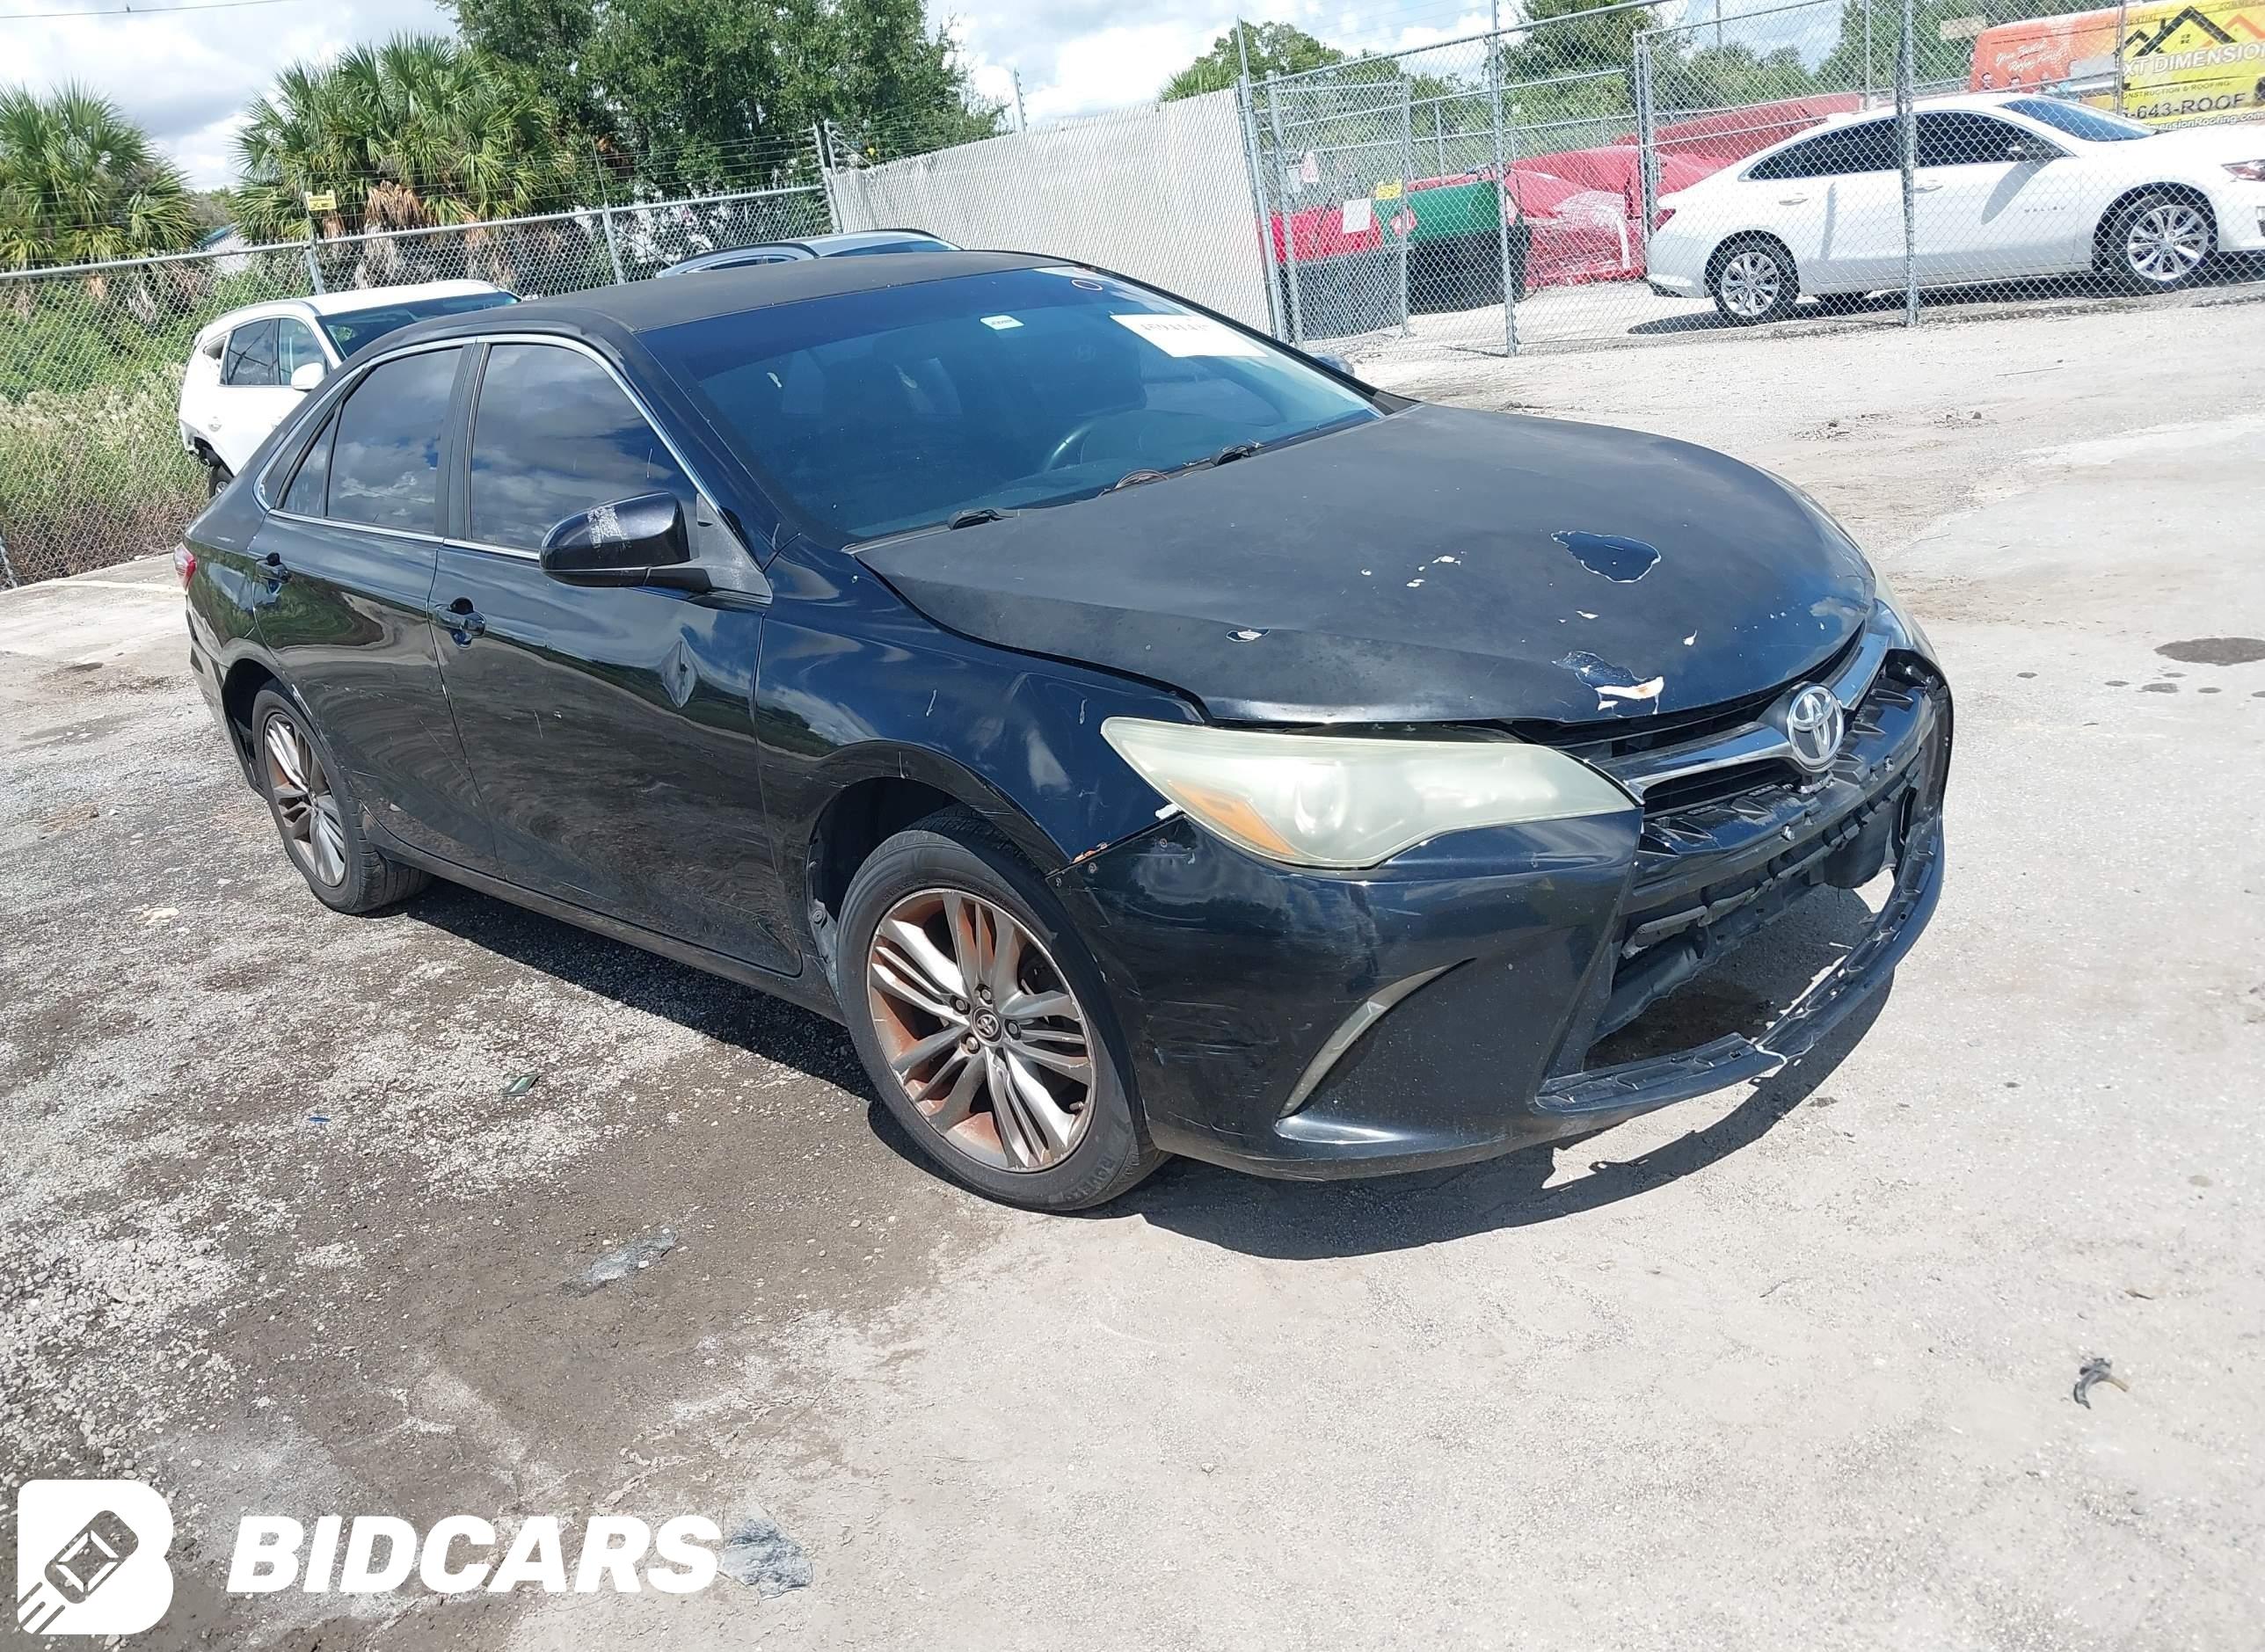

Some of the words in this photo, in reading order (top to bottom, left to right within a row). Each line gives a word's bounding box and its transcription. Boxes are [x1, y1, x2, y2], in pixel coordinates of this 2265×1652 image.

[2123, 57, 2149, 77] XT
[2123, 87, 2181, 99] ONSTRUCTION
[2190, 80, 2231, 91] ROOFING
